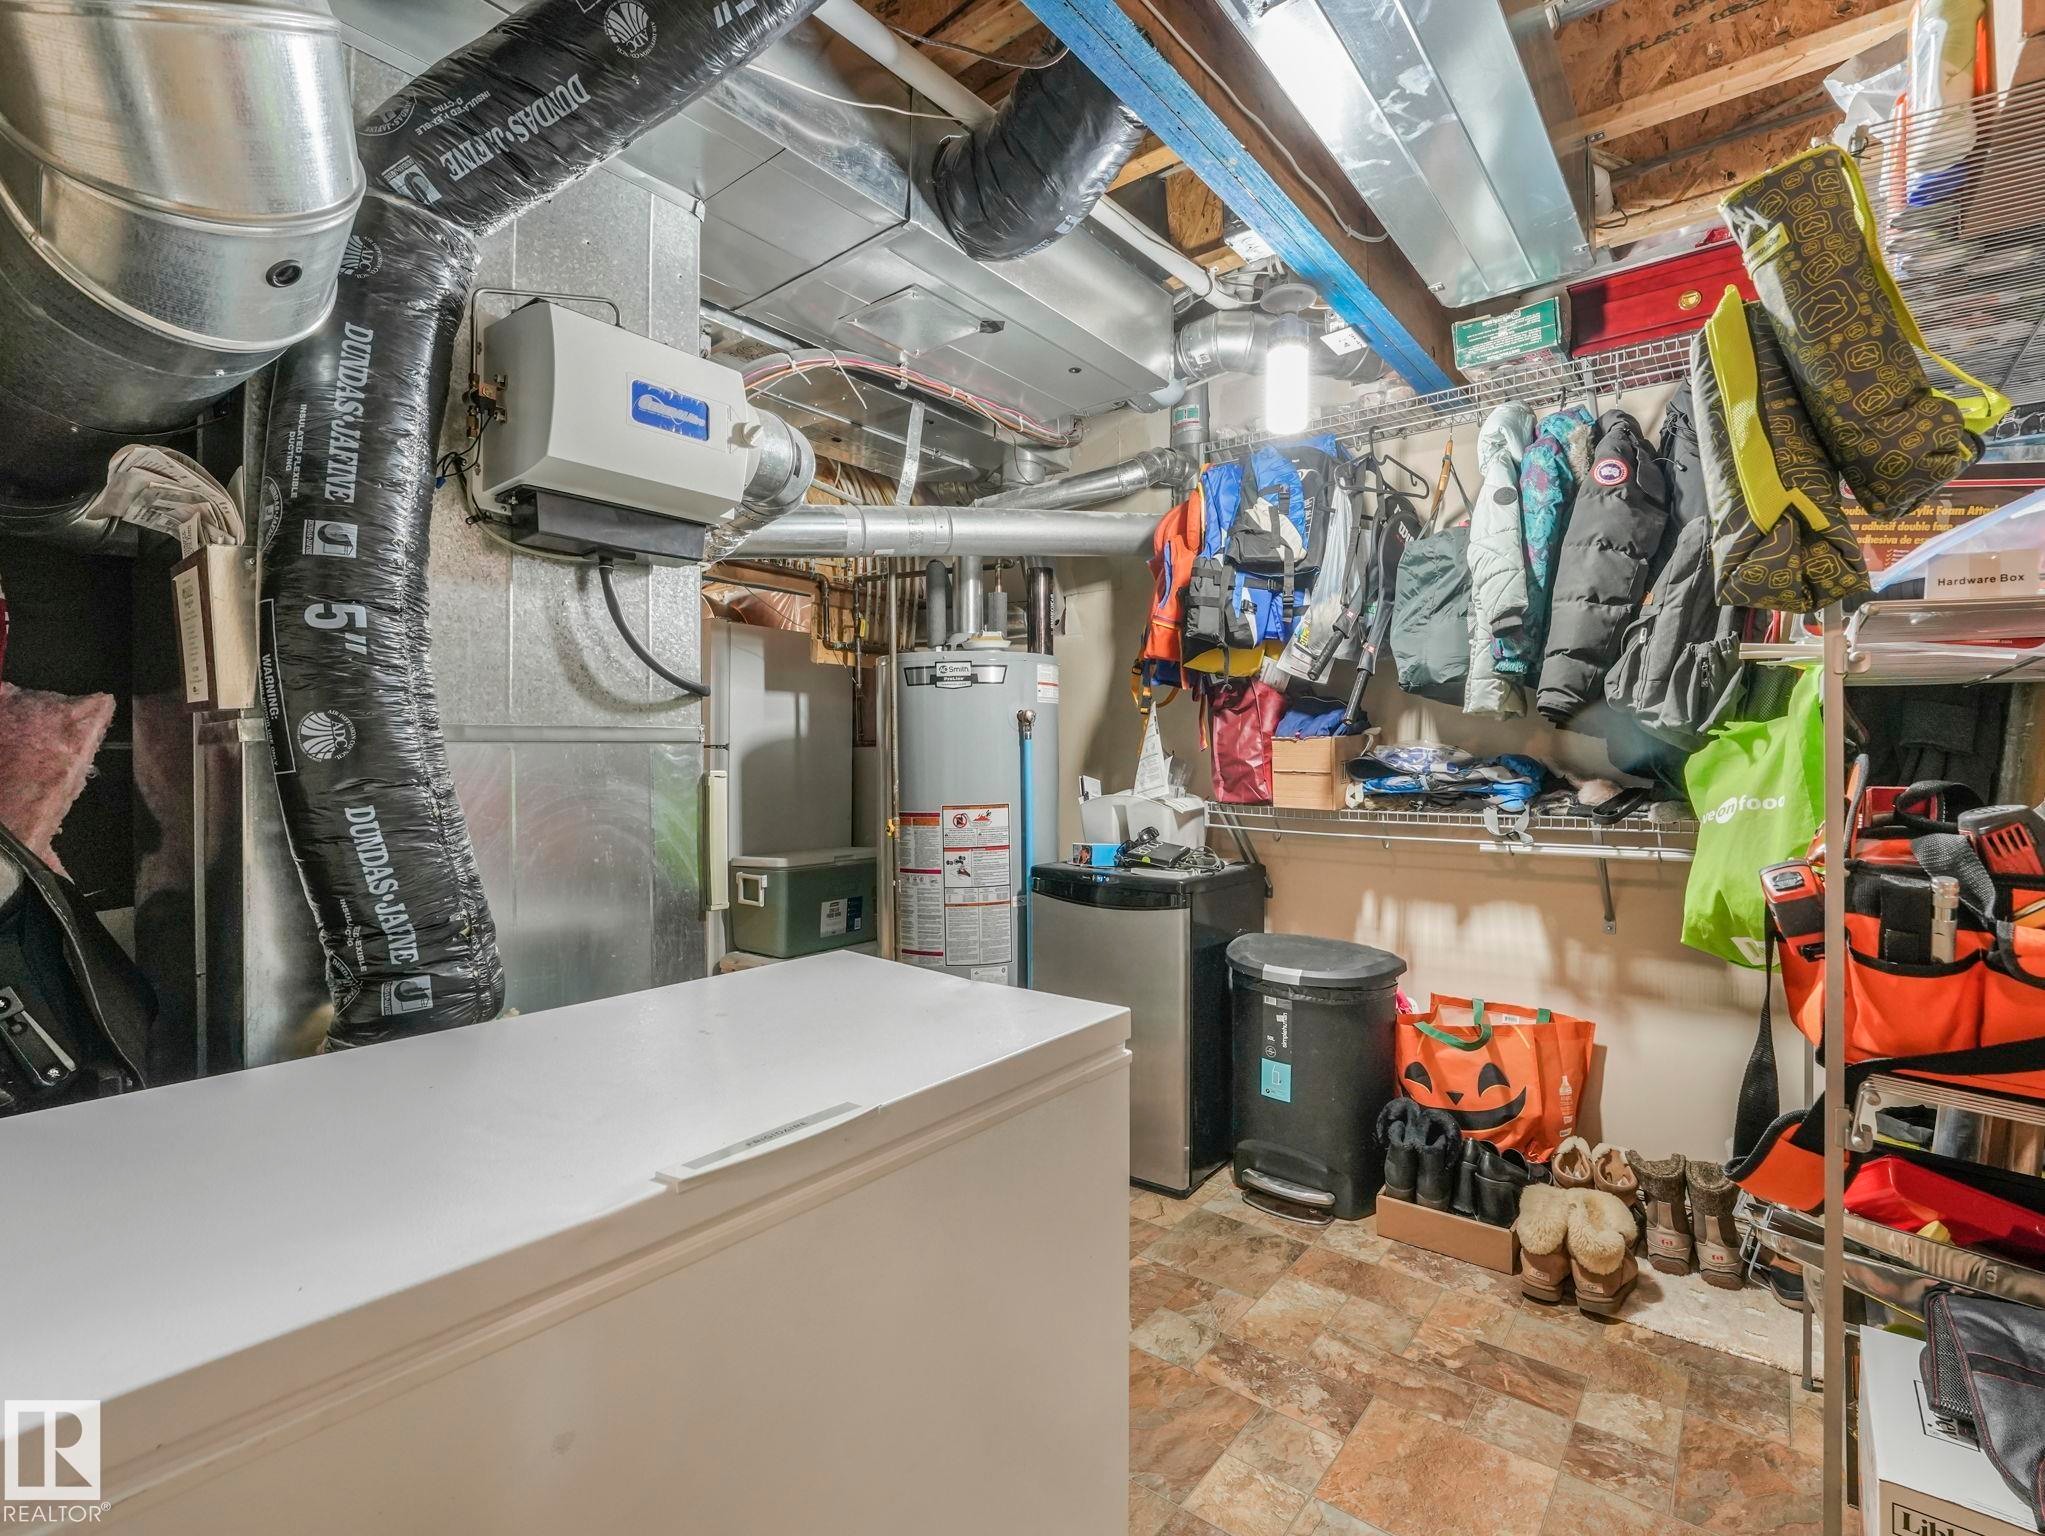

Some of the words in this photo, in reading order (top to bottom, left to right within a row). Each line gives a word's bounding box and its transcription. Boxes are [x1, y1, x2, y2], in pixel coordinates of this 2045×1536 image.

[626, 28, 649, 53] ADC
[296, 404, 307, 454] INSULATED
[285, 431, 296, 472] DUCTING
[290, 455, 303, 499] FLEXIBLE
[1936, 505, 1966, 516] Foam
[1897, 521, 1931, 531] double
[1900, 535, 1912, 544] de
[1937, 576, 1997, 587] Hardware
[2000, 573, 2025, 583] Box
[948, 665, 970, 673] Smith
[261, 653, 280, 720] WARNING:
[331, 720, 348, 751] ADC
